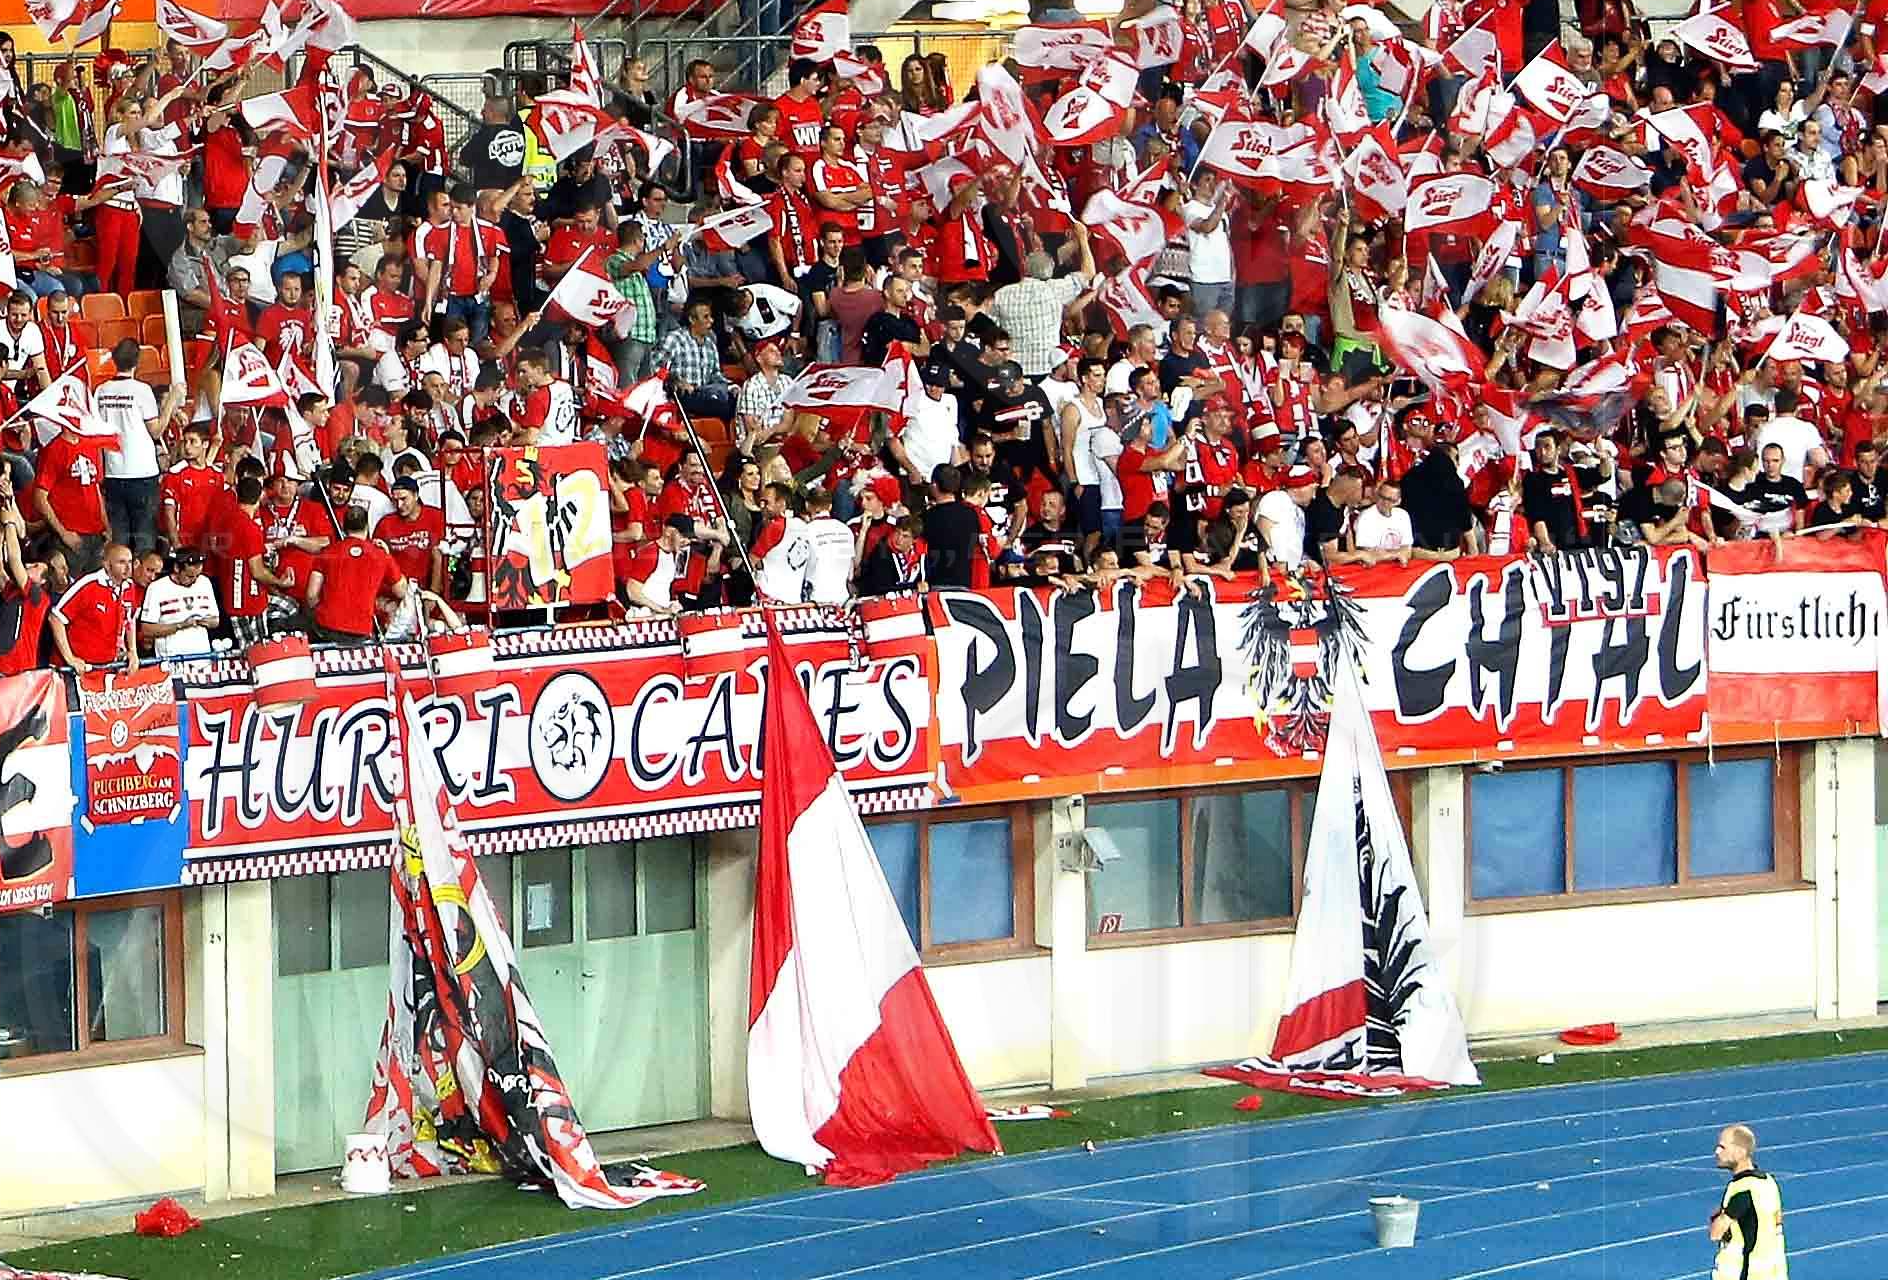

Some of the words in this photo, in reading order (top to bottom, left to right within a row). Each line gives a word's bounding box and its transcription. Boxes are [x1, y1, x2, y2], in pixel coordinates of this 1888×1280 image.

[1786, 323, 1825, 348] Stiegl
[941, 581, 1222, 760] PIELA
[630, 670, 919, 782] CAES
[94, 775, 157, 796] PUCHBERG
[158, 776, 172, 789] AM
[93, 793, 174, 816] SCHNEEBERG
